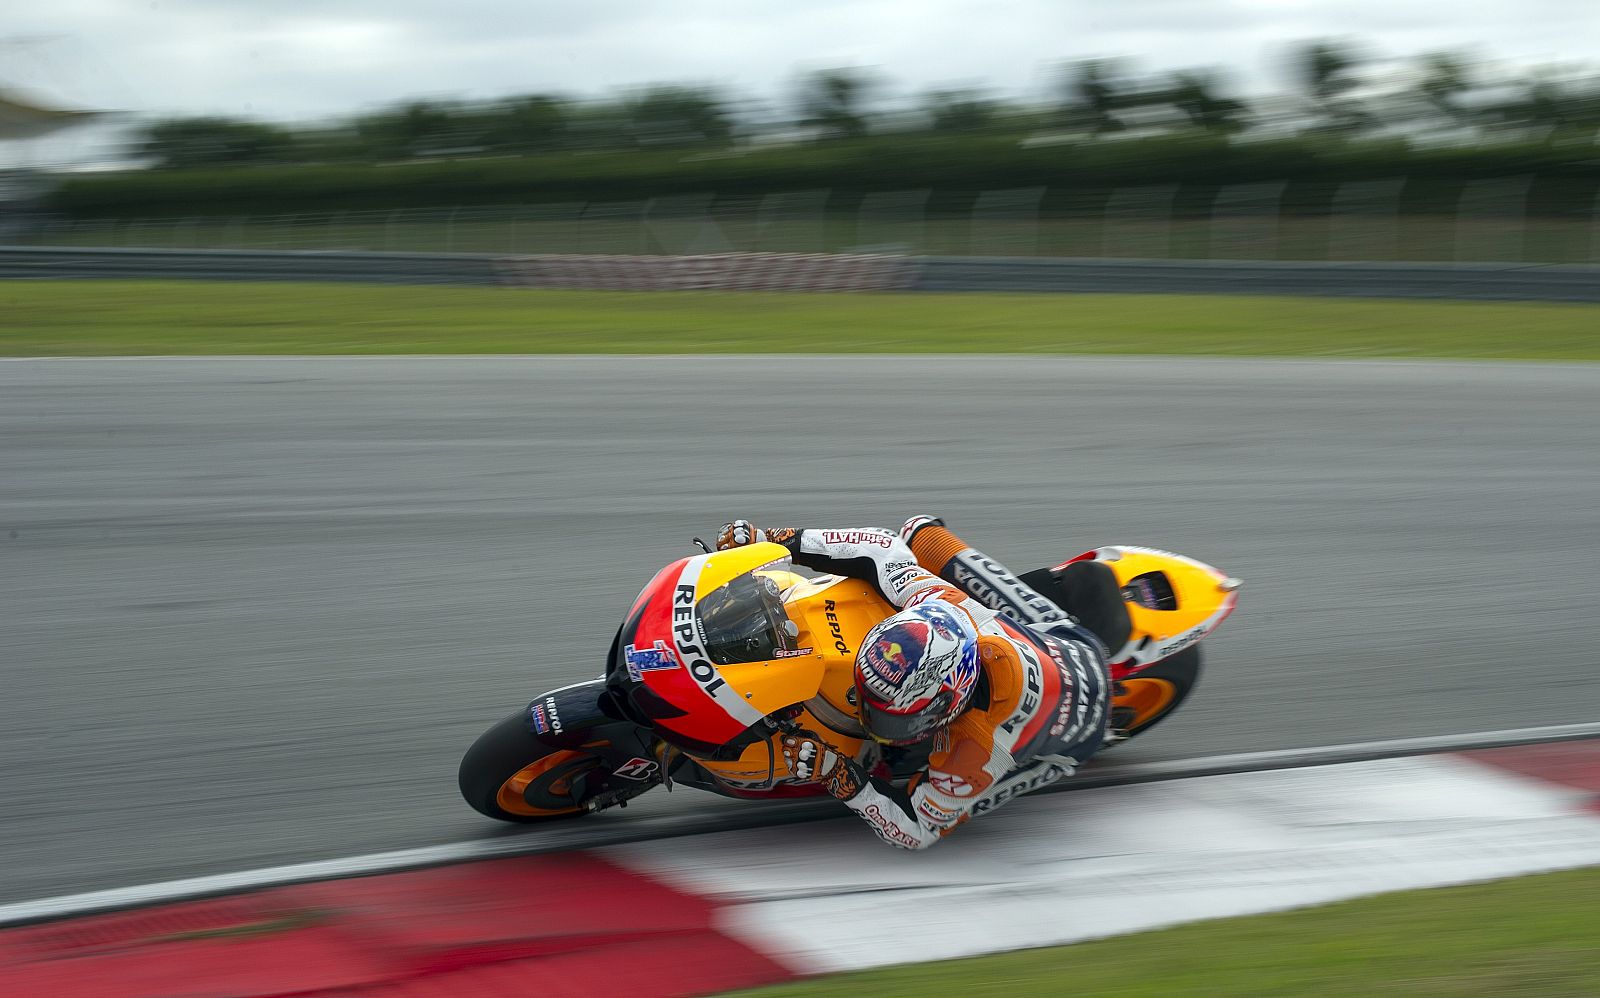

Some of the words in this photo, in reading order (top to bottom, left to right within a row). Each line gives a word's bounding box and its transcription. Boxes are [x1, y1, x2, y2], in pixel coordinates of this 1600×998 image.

[862, 532, 892, 549] Satu
[953, 561, 1026, 625] ONDA
[675, 584, 726, 698] REPSOL
[696, 617, 709, 646] HONDA
[824, 599, 851, 656] REPSOL
[545, 696, 564, 736] REPSOL
[972, 765, 1061, 817] REPSO
